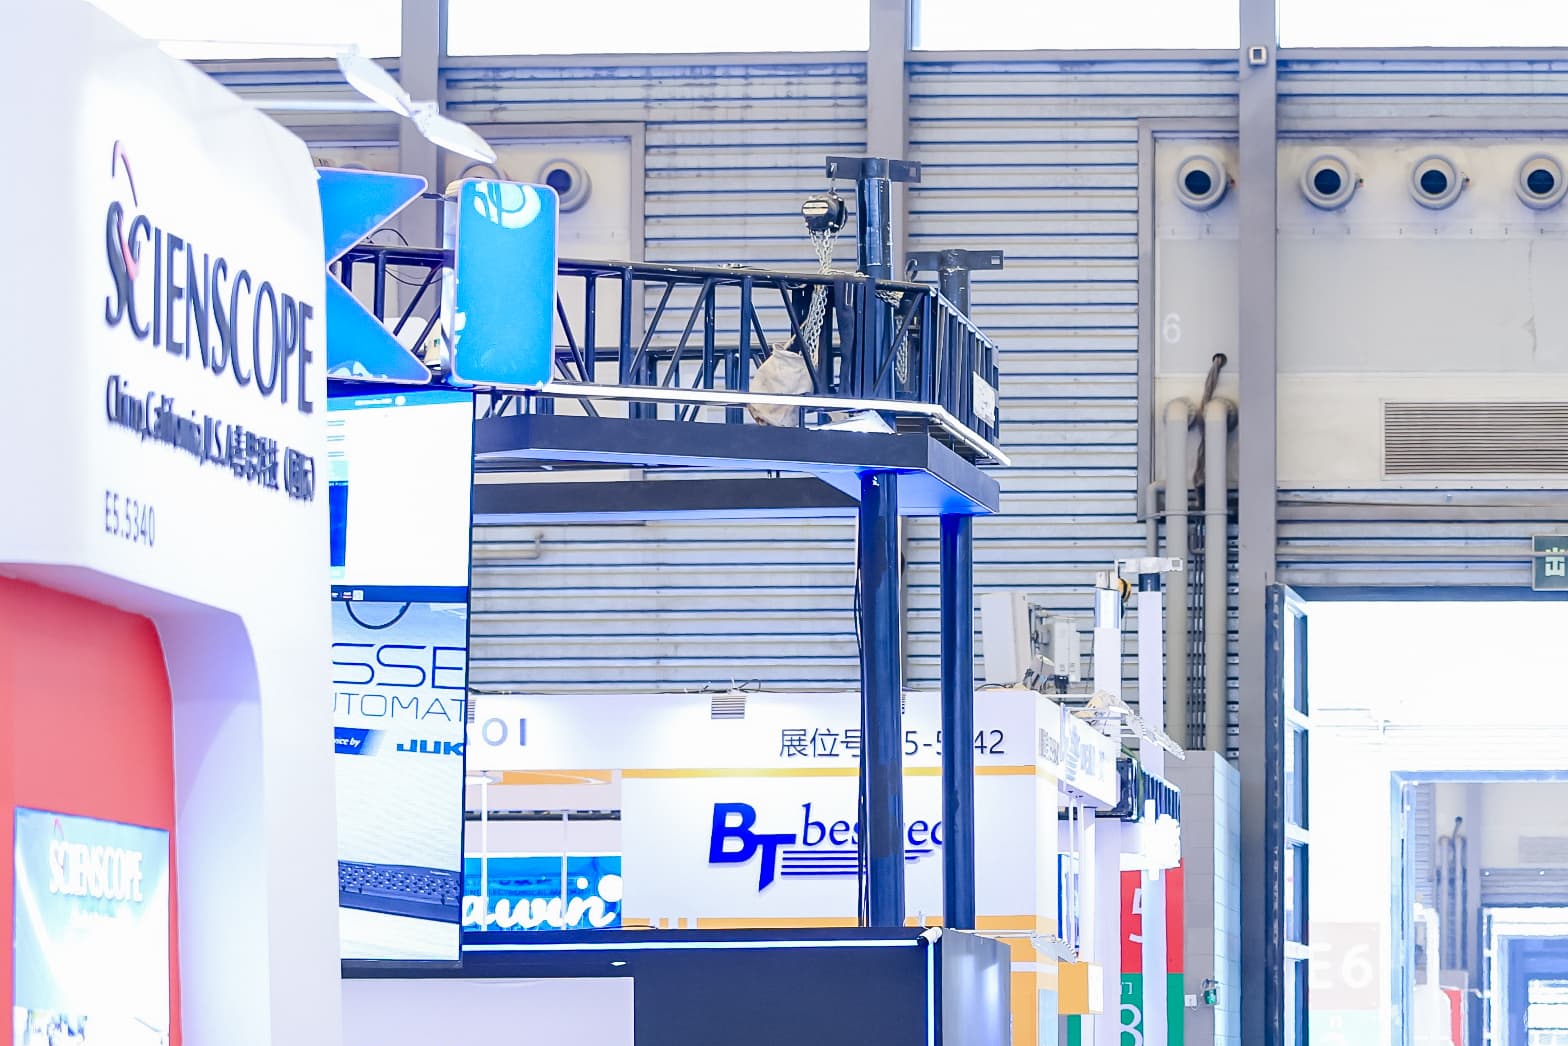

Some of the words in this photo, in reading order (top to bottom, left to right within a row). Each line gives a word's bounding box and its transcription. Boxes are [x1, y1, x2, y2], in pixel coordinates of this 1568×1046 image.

[106, 200, 314, 414] SCIENSCOPE
[1162, 313, 1182, 344] 6
[49, 839, 144, 903] SCIENSCOPE
[708, 802, 797, 893] BT
